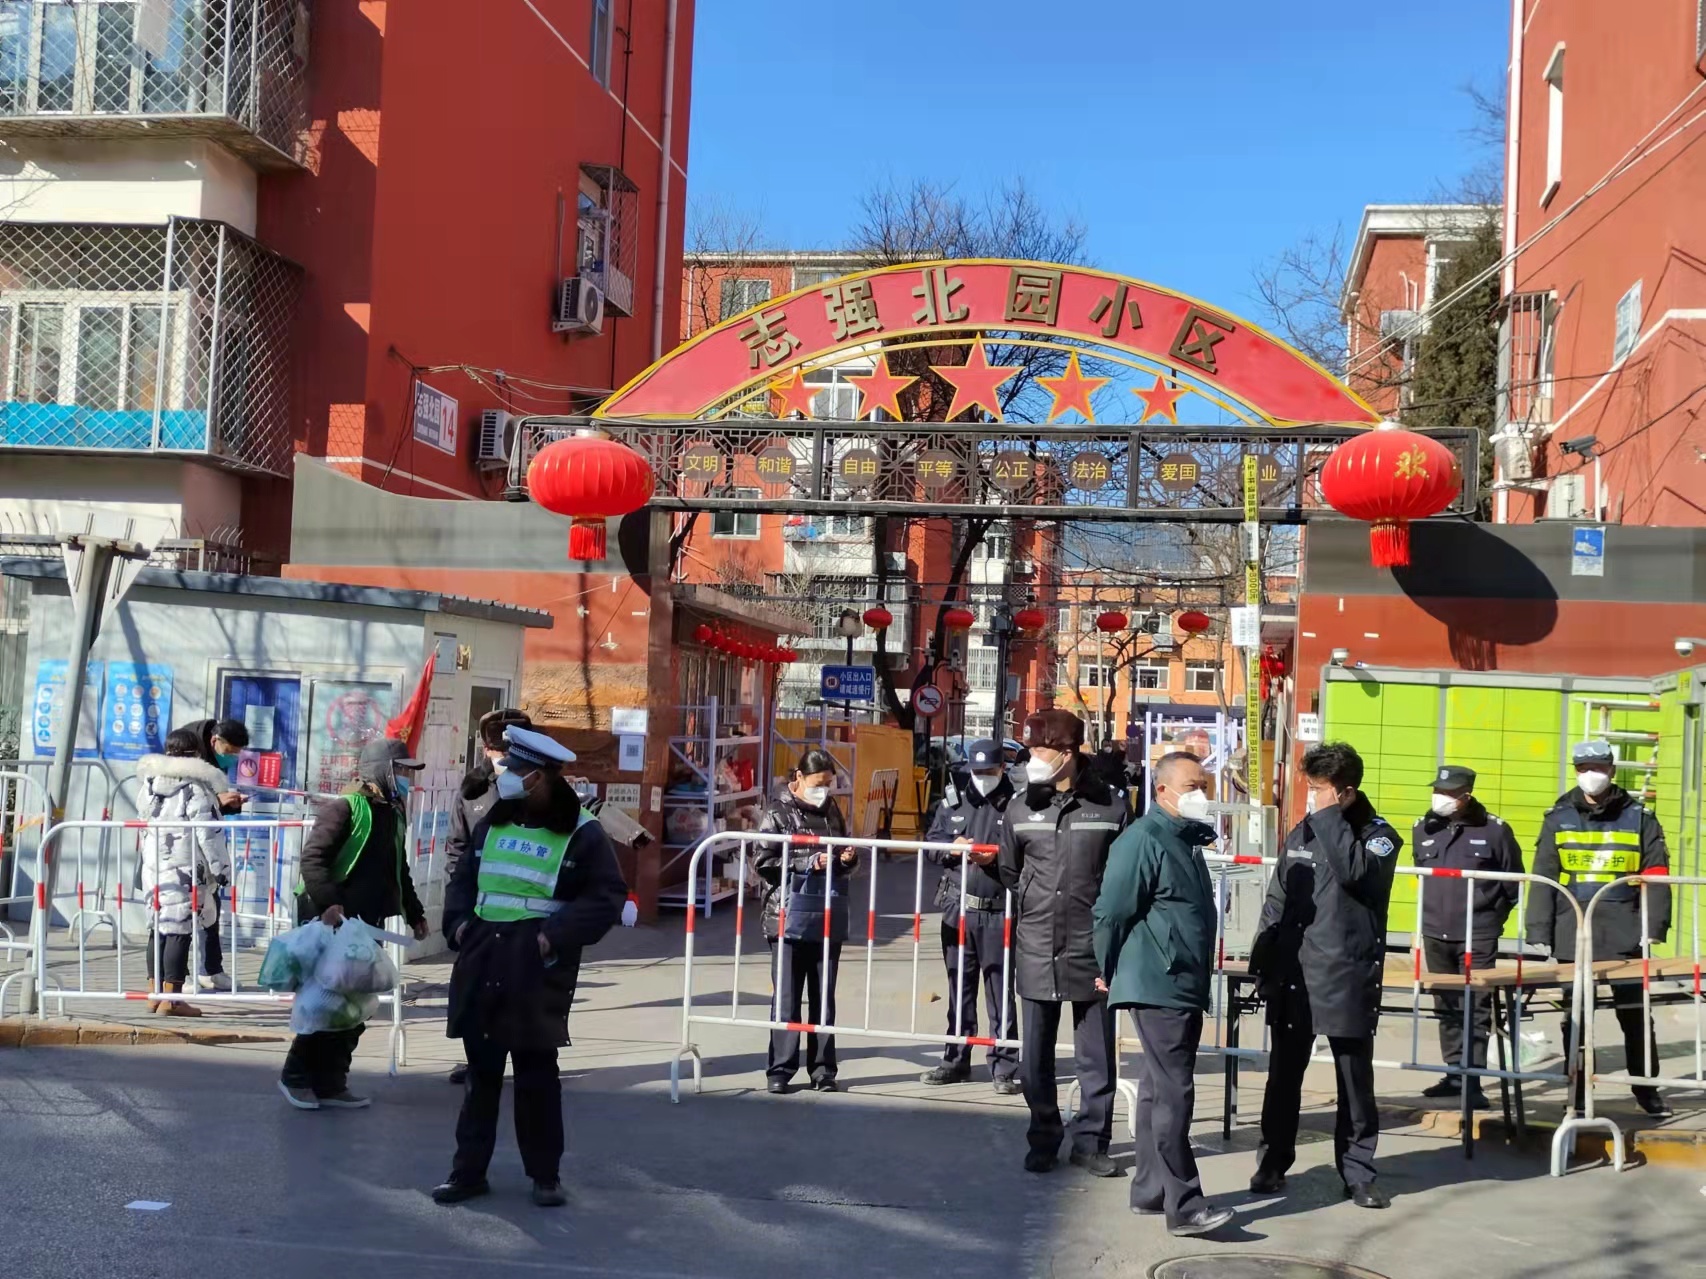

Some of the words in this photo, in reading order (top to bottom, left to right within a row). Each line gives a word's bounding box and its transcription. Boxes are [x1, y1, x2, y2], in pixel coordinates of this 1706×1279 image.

[738, 267, 1236, 374] 志强北园小区
[441, 405, 455, 444] 14
[684, 453, 720, 474] 文明
[757, 454, 792, 476] 和谐
[842, 457, 877, 477] 自由
[917, 458, 953, 479] 平等
[995, 459, 1030, 479] 公正
[1071, 460, 1107, 481] 法治
[1393, 443, 1430, 480] 欢
[1160, 462, 1198, 483] 爱国
[839, 671, 872, 683] 小区出入口
[497, 838, 549, 858] 交通协管
